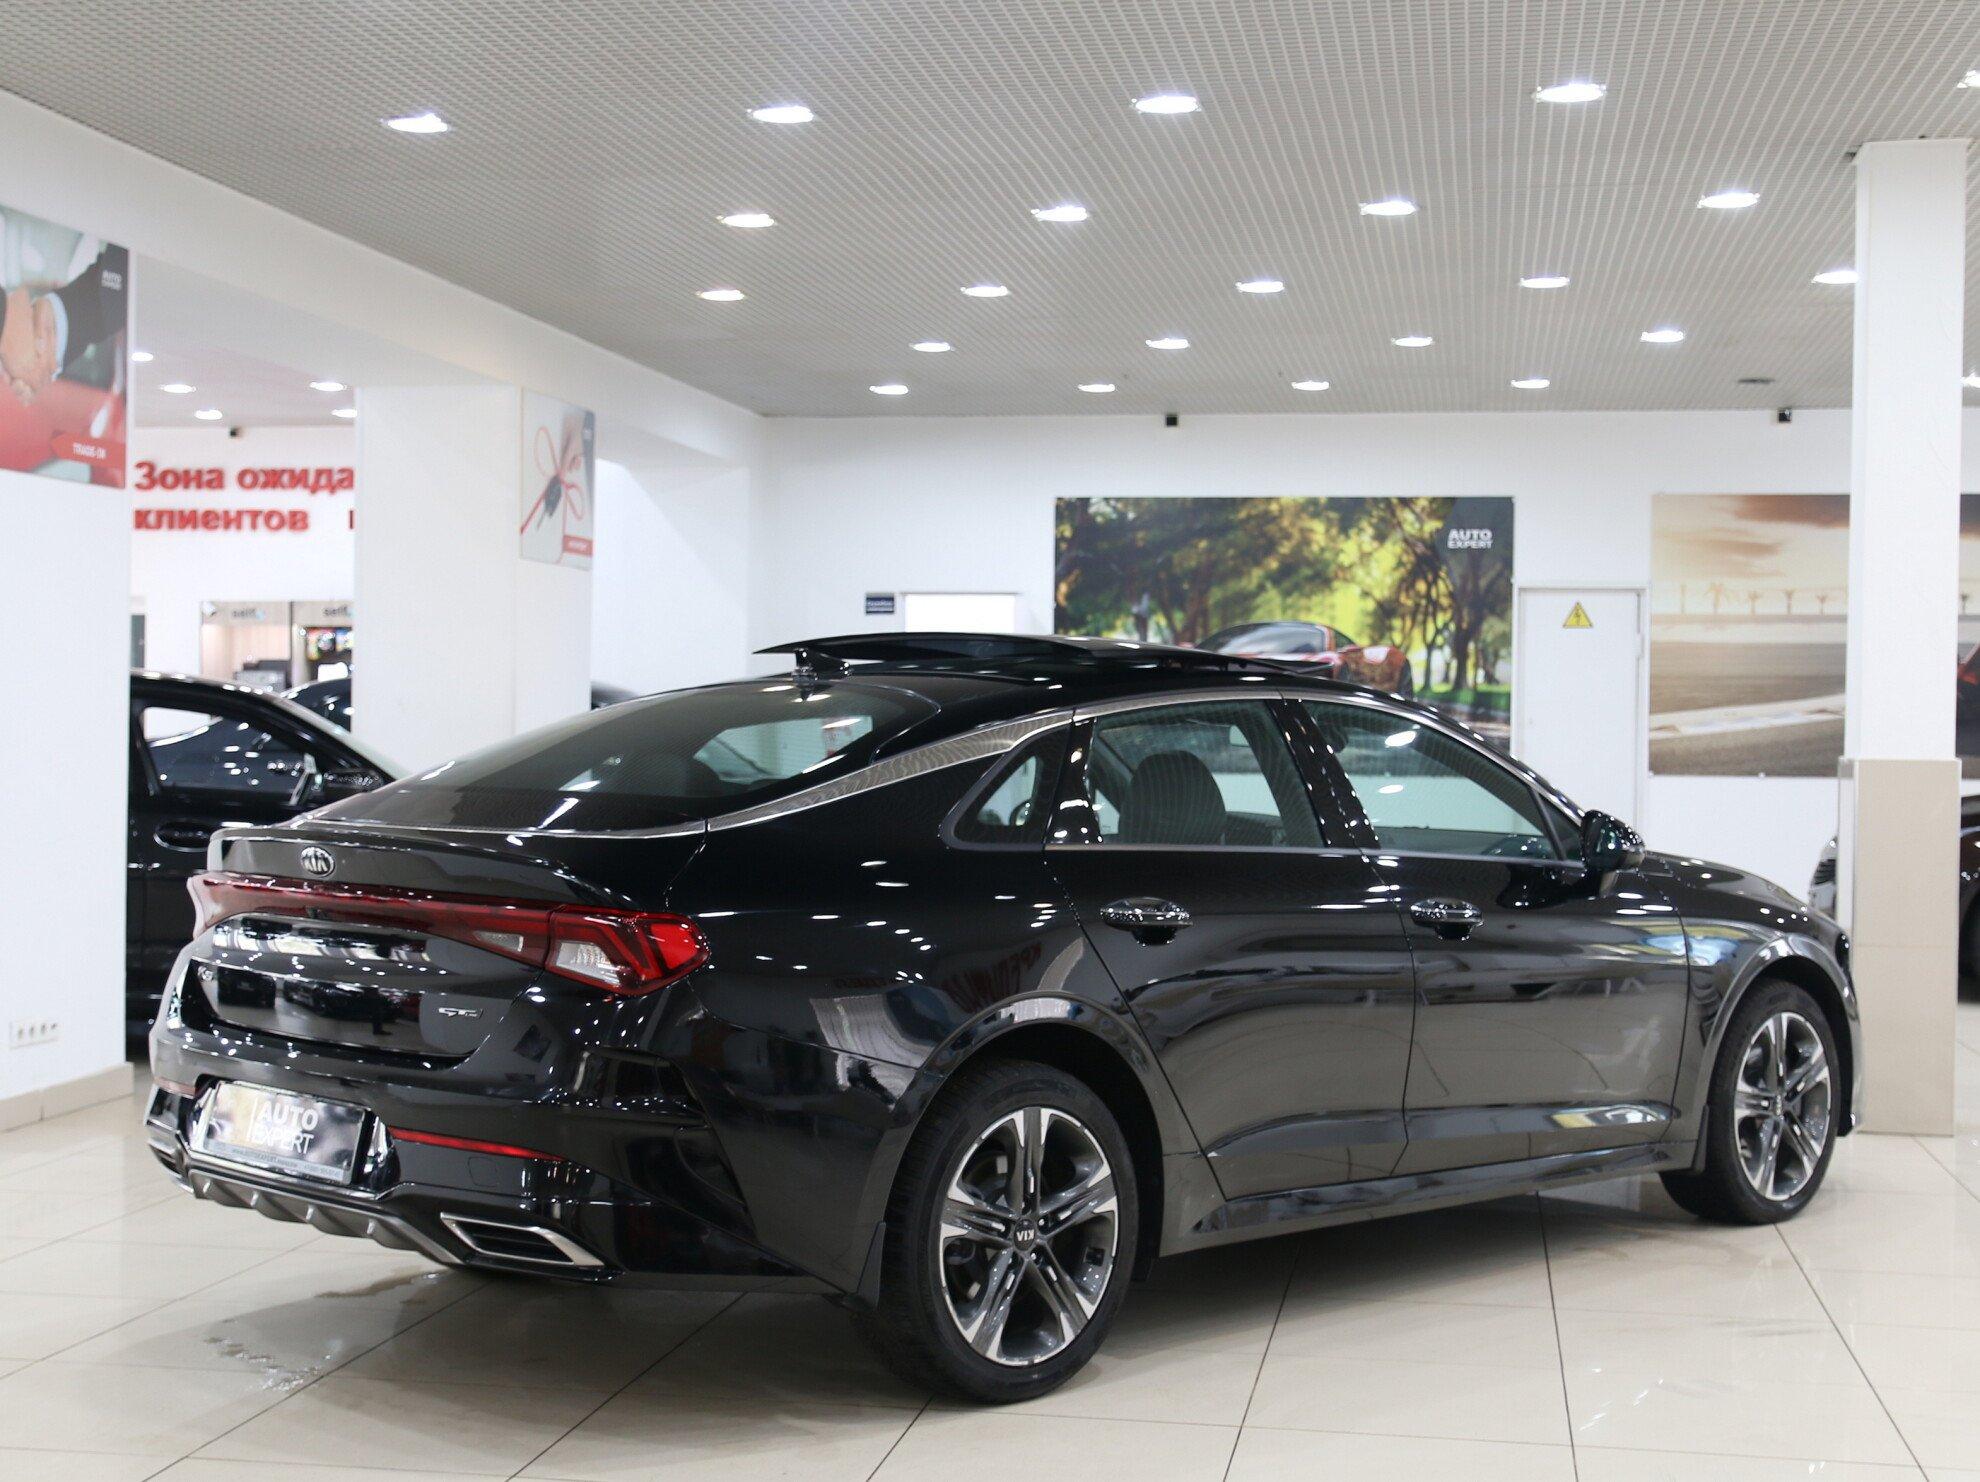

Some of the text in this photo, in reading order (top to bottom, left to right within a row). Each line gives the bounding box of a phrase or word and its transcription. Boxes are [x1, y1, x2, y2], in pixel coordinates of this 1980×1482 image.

[134, 460, 354, 495] Зона ожида
[133, 509, 309, 532] клиентов
[1447, 539, 1493, 549] EXPERT
[1448, 529, 1493, 541] AUTO
[257, 1100, 320, 1132] AUTO
